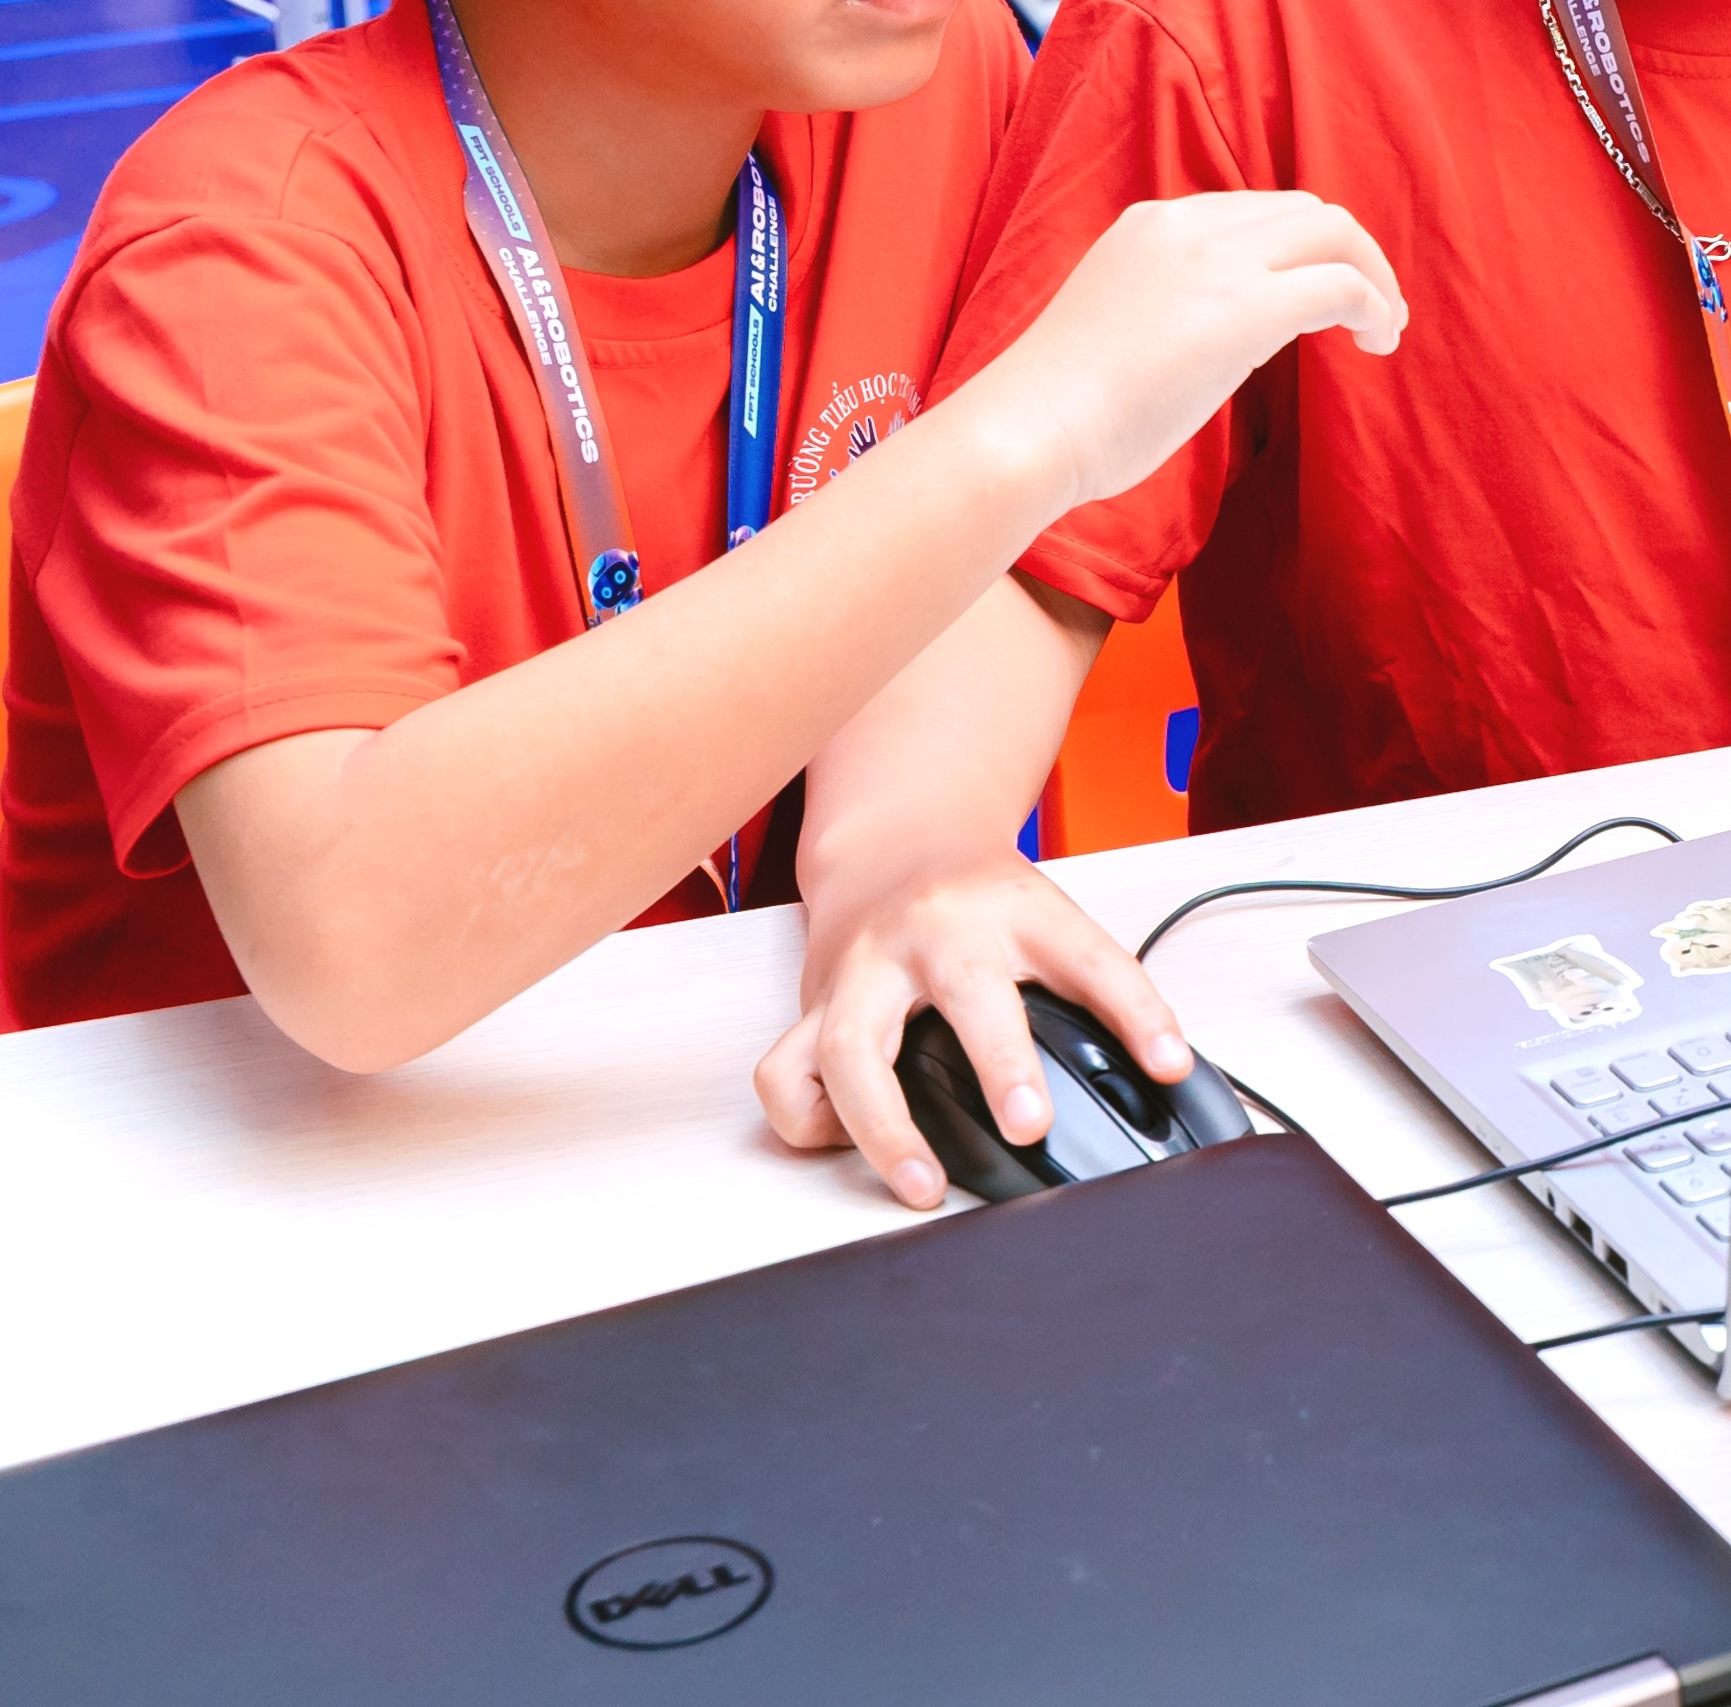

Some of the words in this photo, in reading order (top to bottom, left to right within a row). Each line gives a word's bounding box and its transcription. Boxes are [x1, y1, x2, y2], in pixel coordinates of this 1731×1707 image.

[470, 135, 490, 162] FPT
[485, 165, 522, 232] SCHOOLS
[499, 247, 553, 366] CHALLENGE
[767, 194, 779, 313] CHALLENGE
[516, 246, 599, 464] AI&ROBOTICS
[747, 391, 756, 422] FPT
[788, 427, 831, 505] RƯỜNG
[819, 381, 859, 431] TIỂU
[859, 372, 898, 404] HỌC
[590, 1563, 753, 1625] DELL
